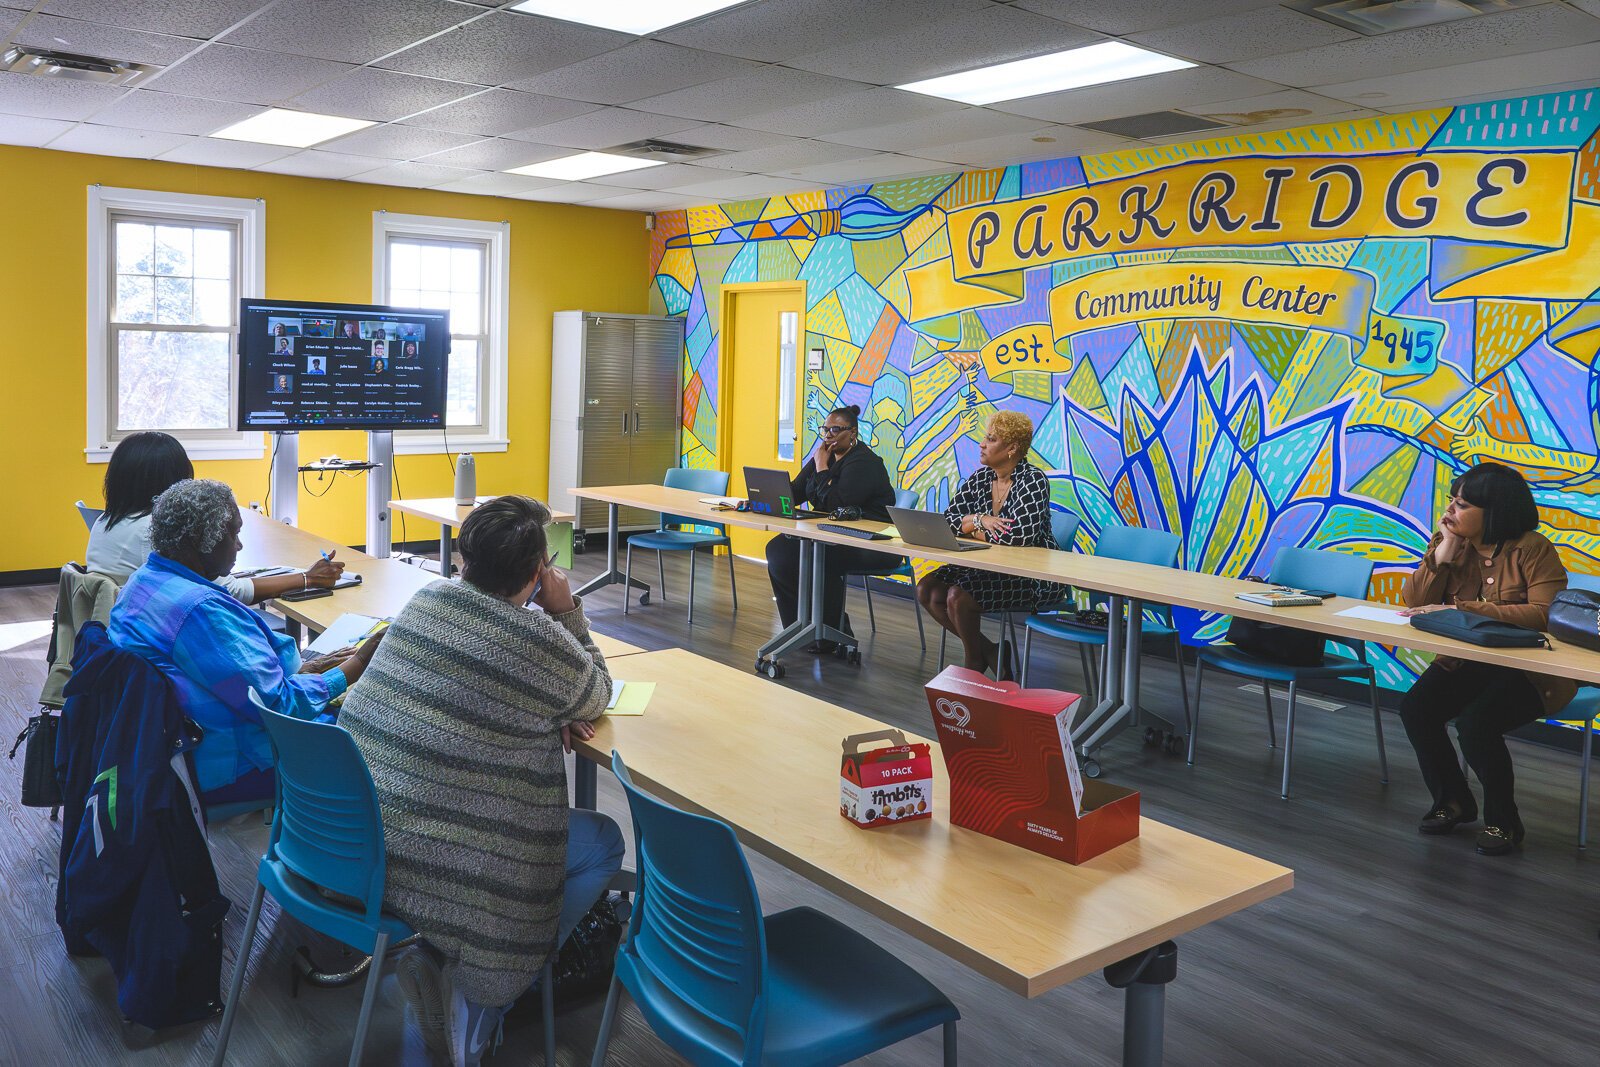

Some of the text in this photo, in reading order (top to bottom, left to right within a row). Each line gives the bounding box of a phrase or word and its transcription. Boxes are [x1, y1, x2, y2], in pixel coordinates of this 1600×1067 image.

[968, 157, 1528, 269] PARKRIDGE
[1075, 273, 1337, 320] Community Center
[995, 333, 1050, 365] est.
[1371, 319, 1436, 363] 1945
[881, 767, 912, 778] 10 PACK
[872, 784, 922, 806] timbits
